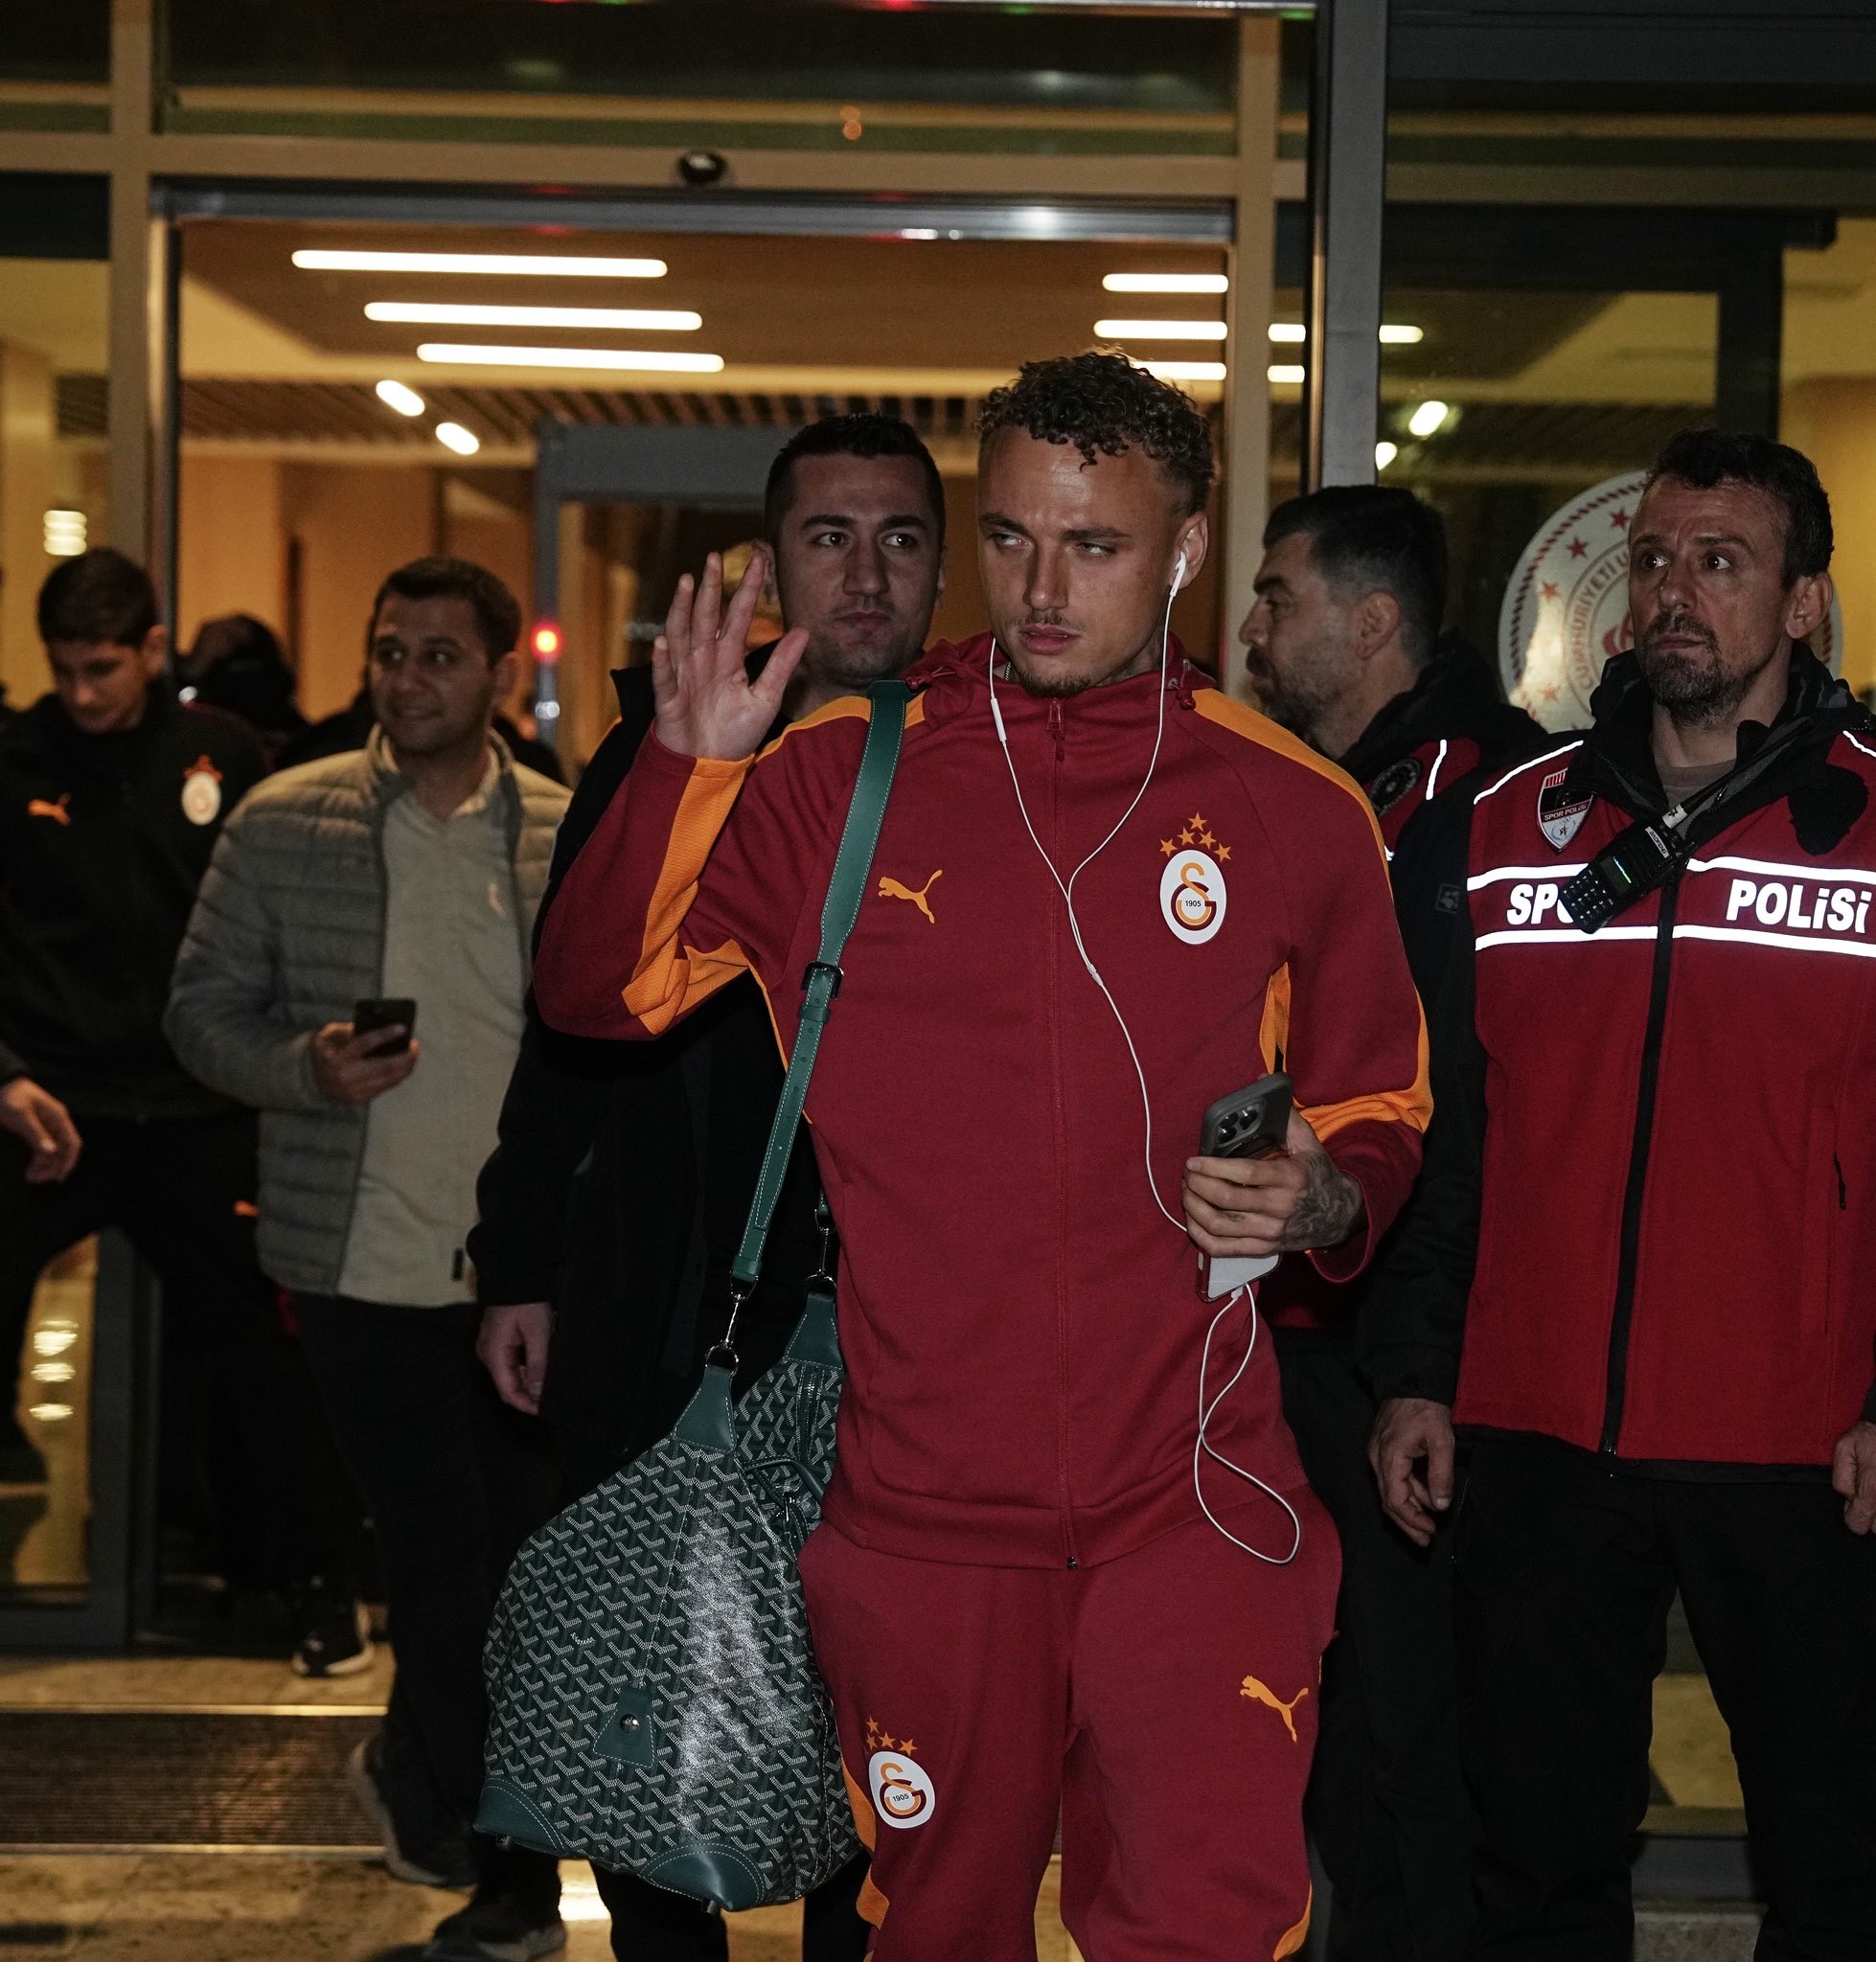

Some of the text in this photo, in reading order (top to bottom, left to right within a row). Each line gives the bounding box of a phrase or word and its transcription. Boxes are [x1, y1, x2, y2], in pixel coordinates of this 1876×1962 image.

[1544, 810, 1564, 821] SPOR
[1506, 883, 1573, 925] SP
[892, 1792, 909, 1802] 1905
